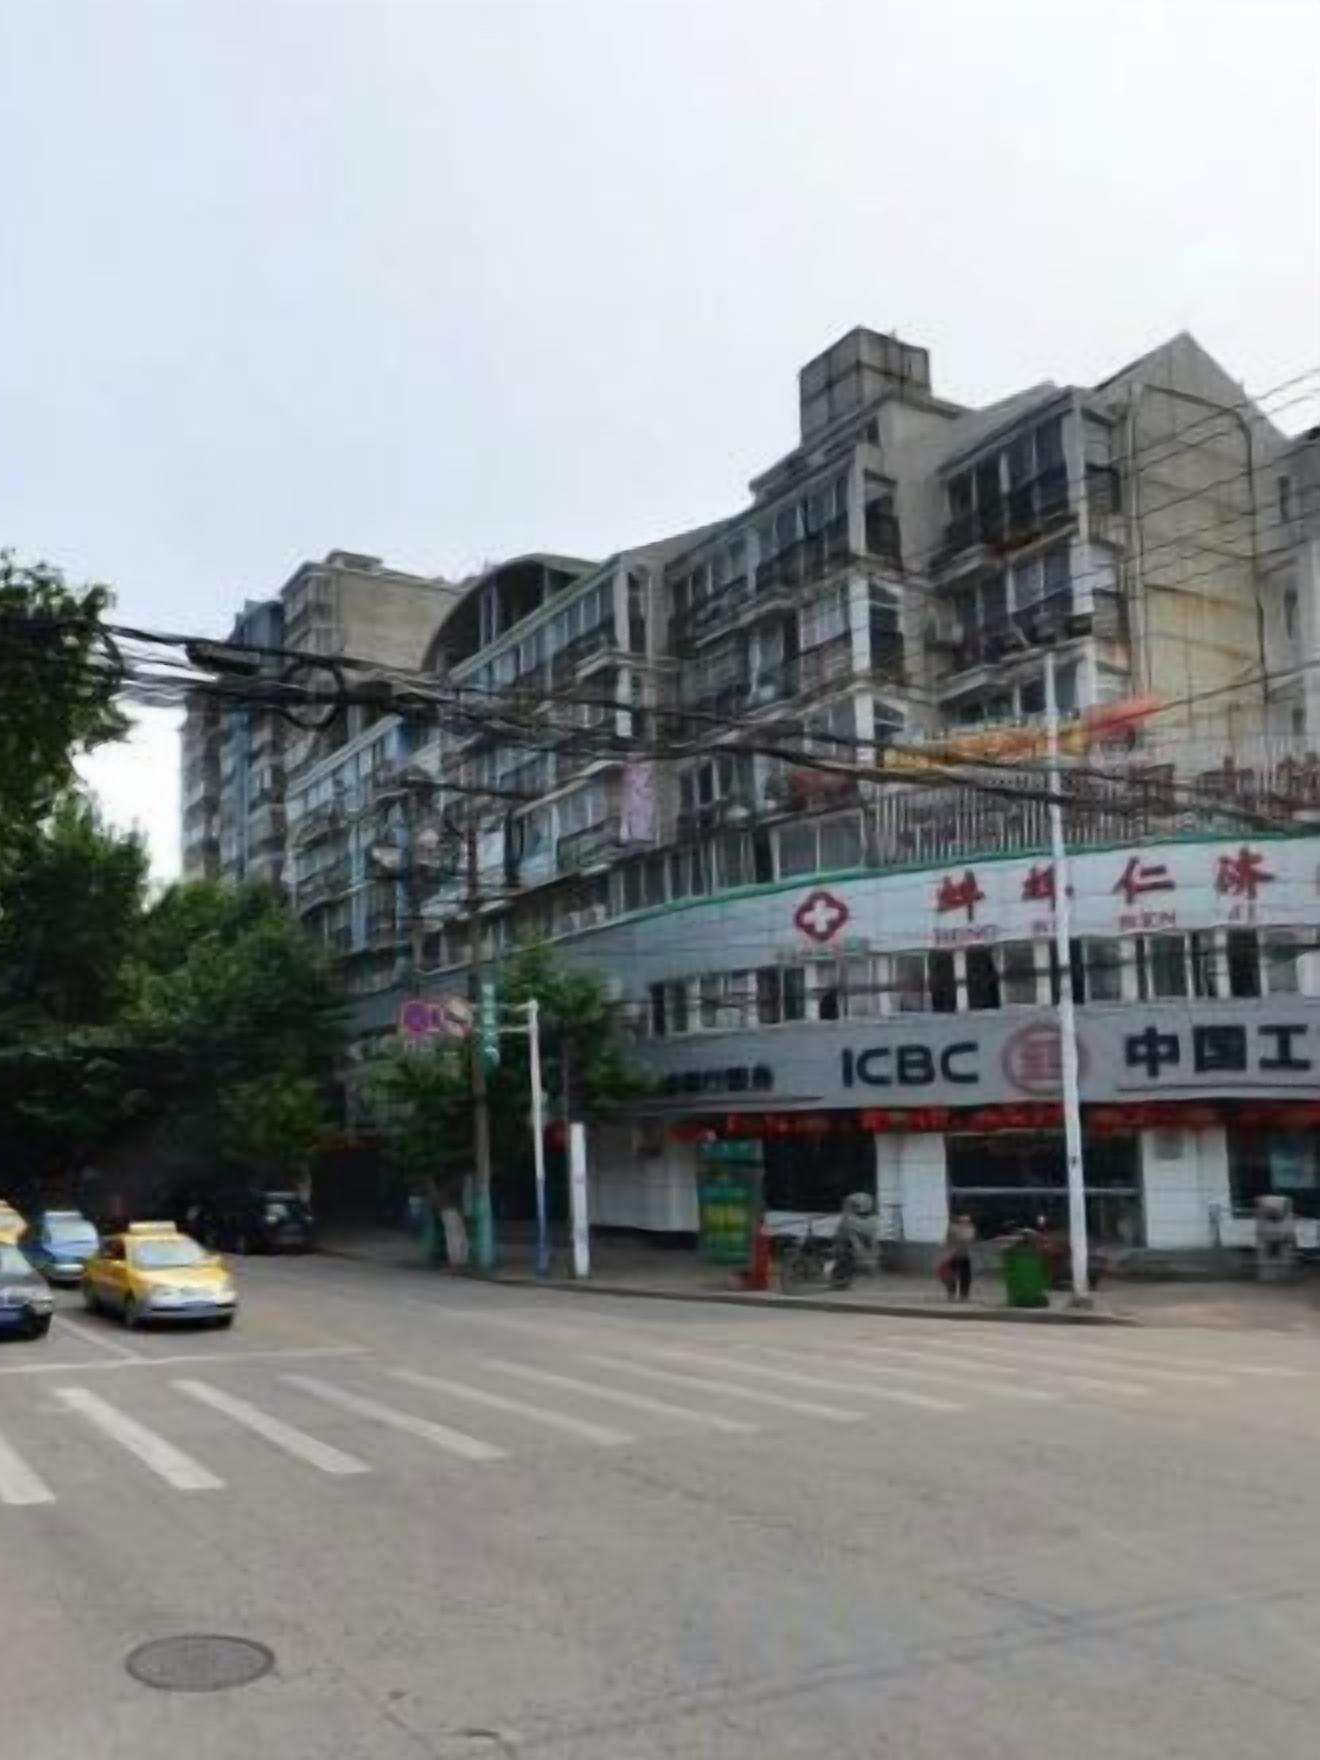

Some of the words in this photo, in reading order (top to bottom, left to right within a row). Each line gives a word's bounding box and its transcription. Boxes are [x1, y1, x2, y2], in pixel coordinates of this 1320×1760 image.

[840, 1040, 980, 1088] ICBC
[1124, 1023, 1312, 1078] 中国工
